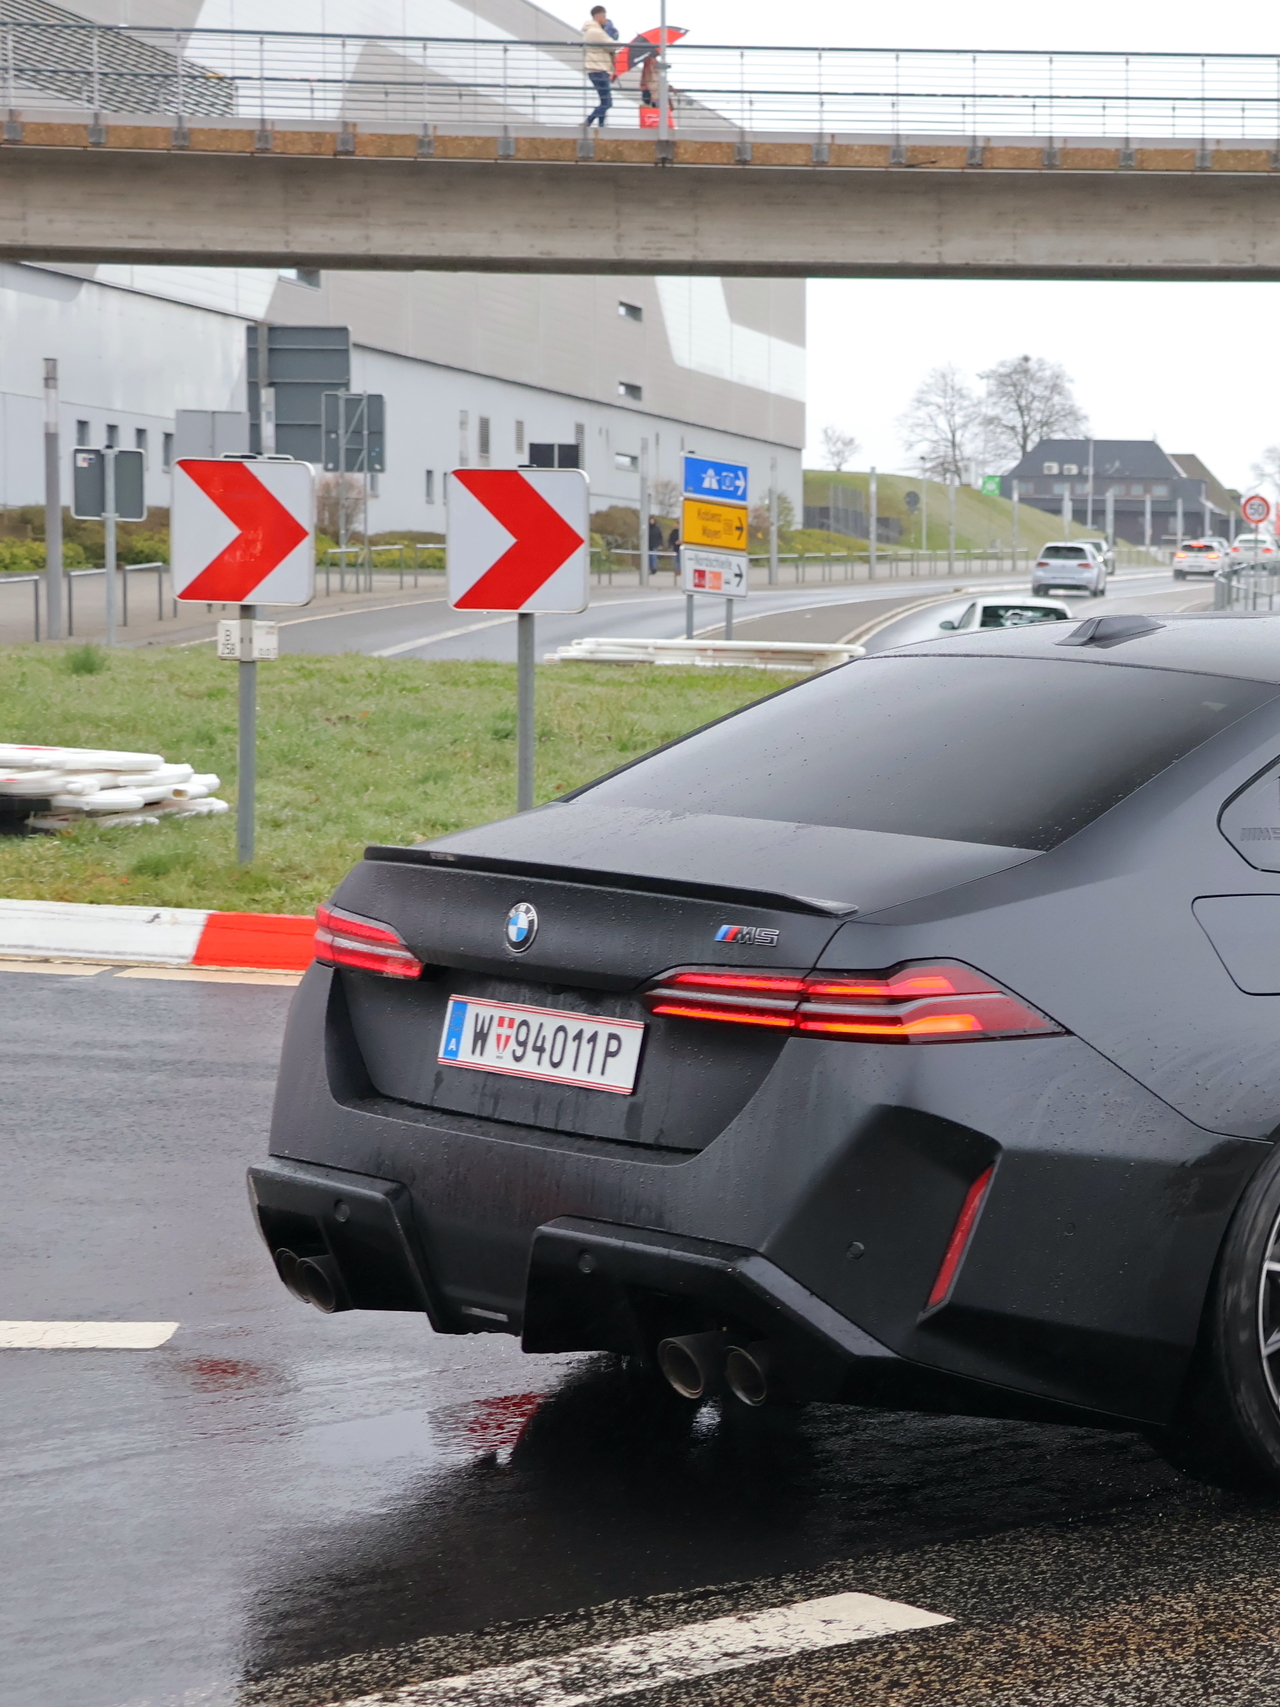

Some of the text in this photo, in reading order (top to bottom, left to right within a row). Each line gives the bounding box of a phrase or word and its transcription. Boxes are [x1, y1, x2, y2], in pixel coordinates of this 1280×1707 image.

[1249, 503, 1266, 517] 50
[225, 629, 232, 641] B
[508, 903, 536, 921] BMW
[727, 925, 780, 947] M5
[447, 1038, 457, 1051] A
[471, 1012, 623, 1076] W 94011P
